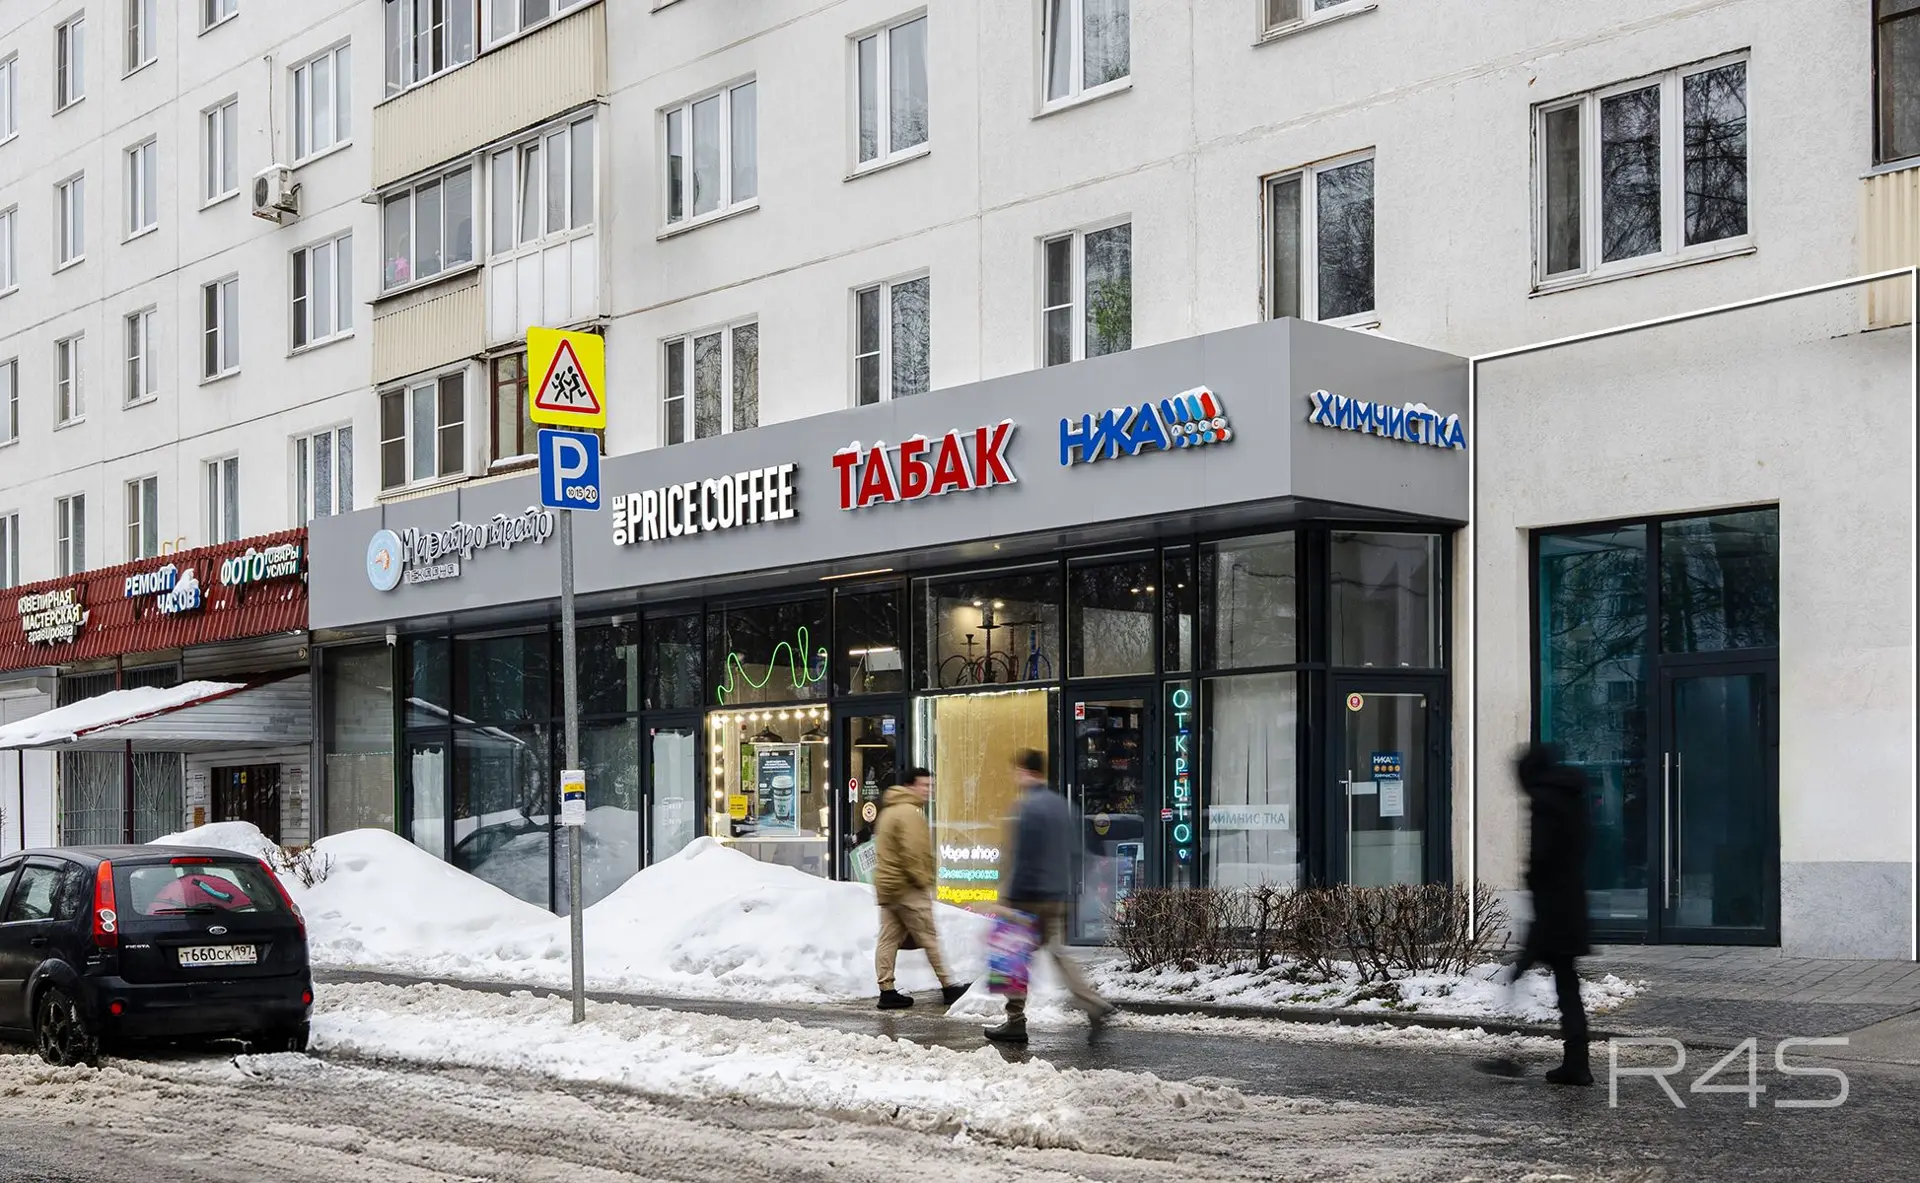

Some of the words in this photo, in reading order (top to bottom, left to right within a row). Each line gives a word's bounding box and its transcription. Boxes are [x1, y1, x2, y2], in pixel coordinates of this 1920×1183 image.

[1059, 402, 1171, 467] НИКА
[1311, 390, 1466, 450] ХИМЧИСТКА
[552, 436, 588, 501] P
[832, 419, 1017, 511] ТАБАК
[612, 495, 627, 546] ONE
[627, 481, 699, 544] PRICE
[701, 463, 797, 531] COFFEE
[402, 523, 487, 564] Маэстро
[125, 568, 177, 597] РЕМОНТ
[220, 552, 264, 586] ФОТО
[264, 545, 299, 564] ТОВАРЫ
[265, 559, 297, 578] УСЛУГИ
[18, 589, 74, 614] ЮВЕЛИРНАЯ
[22, 604, 82, 631] МАСТЕРСКАЯ
[157, 588, 199, 614] ЧАСОВ
[1173, 689, 1190, 842] ОТКРЫТО
[940, 844, 969, 863] Vape
[971, 844, 999, 863] shop
[235, 946, 252, 956] 197
